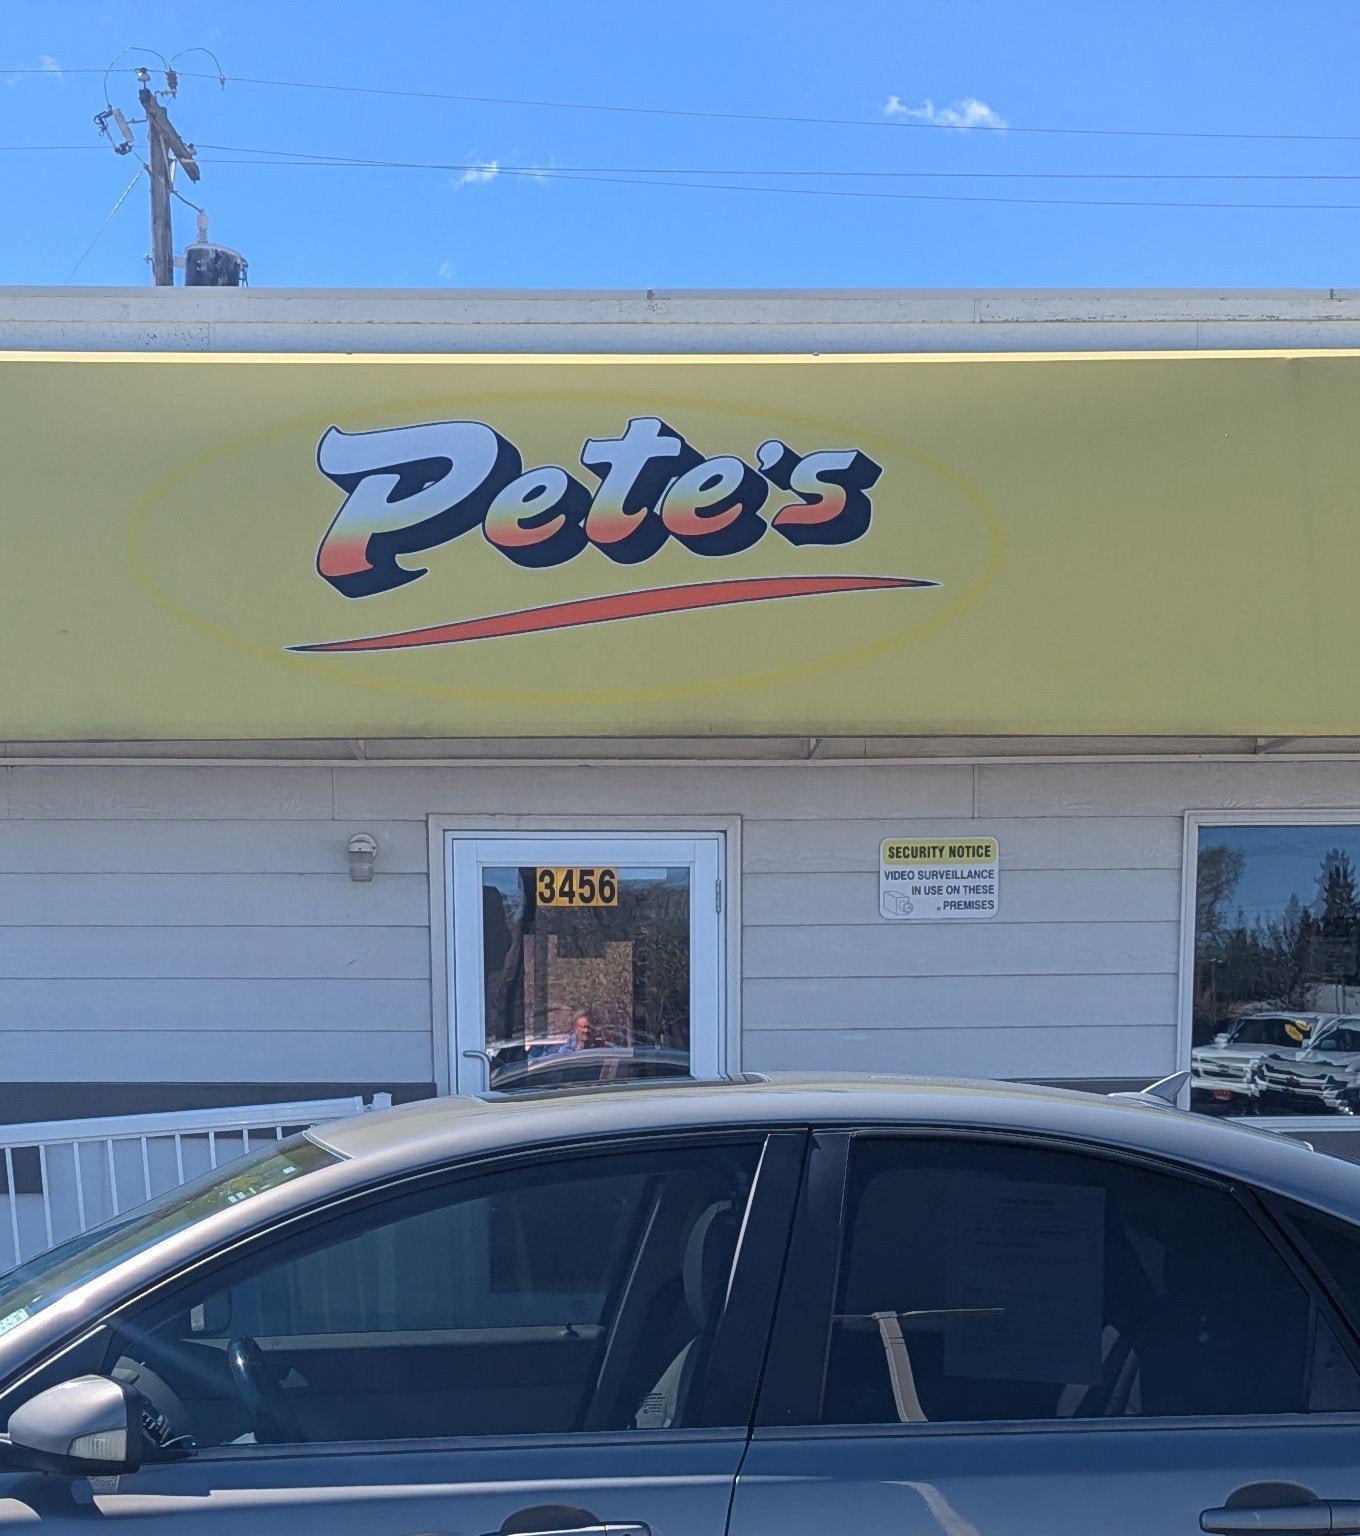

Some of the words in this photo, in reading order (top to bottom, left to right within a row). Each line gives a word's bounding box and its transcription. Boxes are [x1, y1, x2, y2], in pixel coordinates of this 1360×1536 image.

[317, 416, 882, 598] Pete's
[888, 845, 945, 859] SECURITY
[948, 845, 992, 858] NOTICE
[885, 871, 915, 880] VIDEO
[918, 869, 994, 880] SURVEILLANCE
[538, 869, 616, 904] 3456
[911, 885, 921, 896] IN
[924, 885, 943, 896] USE
[945, 885, 961, 895] ON
[963, 884, 994, 895] THESE
[943, 901, 994, 910] PREMISES
